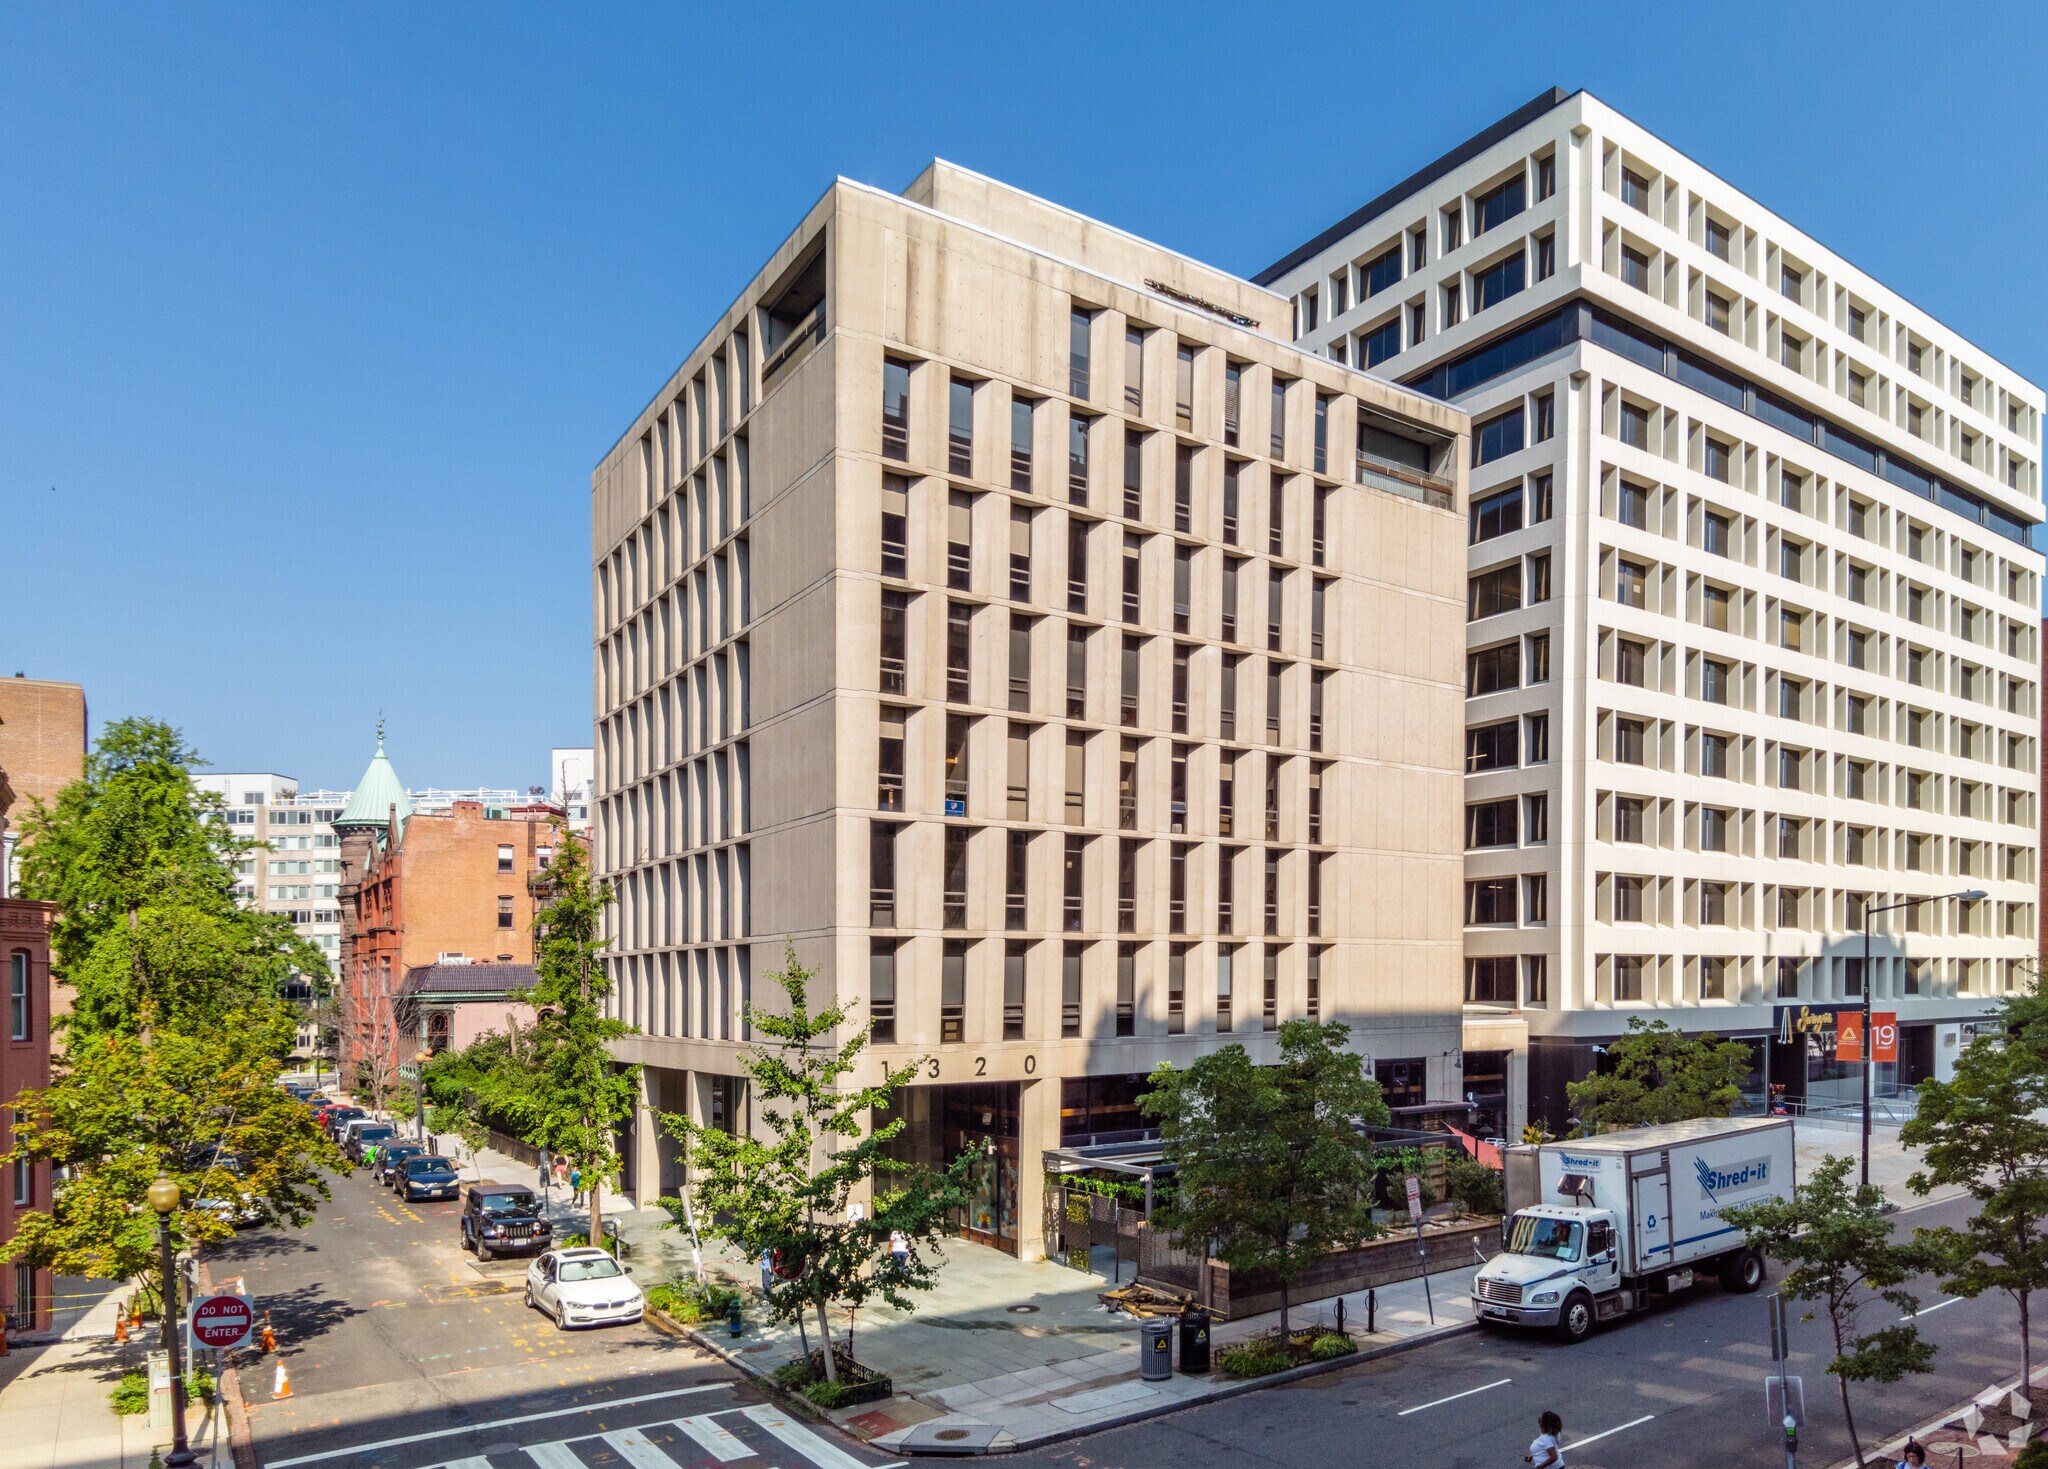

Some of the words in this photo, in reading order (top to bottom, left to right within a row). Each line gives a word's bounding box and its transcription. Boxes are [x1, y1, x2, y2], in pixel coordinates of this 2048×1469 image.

[1872, 1025, 1895, 1046] 19
[1565, 1156, 1599, 1167] Shred-it
[1708, 1161, 1767, 1190] Shred-it
[1700, 1208, 1720, 1221] Makin
[202, 1306, 216, 1315] DO
[223, 1305, 244, 1314] NOT
[205, 1327, 239, 1338] ENTER
